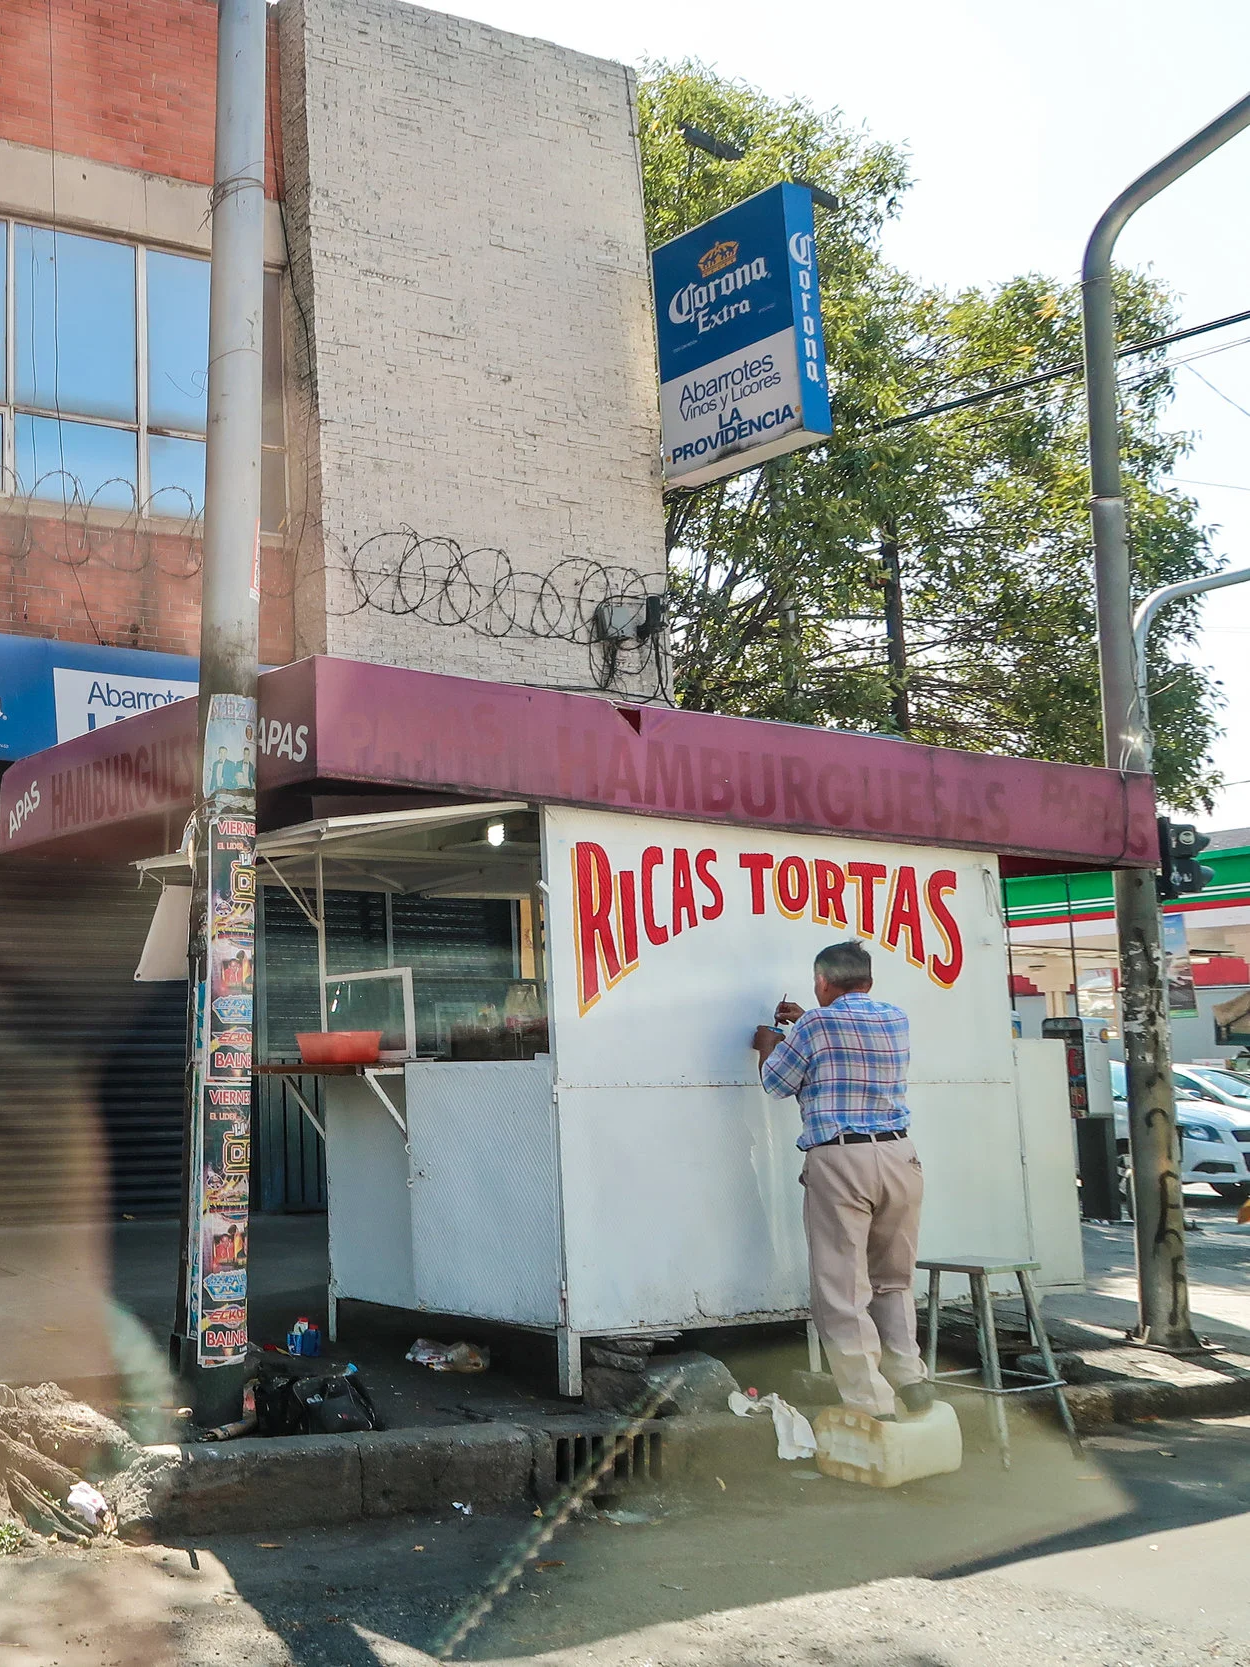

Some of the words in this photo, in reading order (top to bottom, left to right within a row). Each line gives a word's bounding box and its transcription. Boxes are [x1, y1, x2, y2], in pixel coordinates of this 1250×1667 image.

[668, 255, 769, 324] Corona
[697, 299, 751, 334] Extra
[788, 232, 820, 383] Corona
[679, 354, 774, 409] Abarrotes
[679, 395, 718, 422] Vinos
[719, 392, 730, 411] y
[731, 371, 781, 402] Licores
[672, 404, 795, 465] PROVIDENCIA
[718, 407, 743, 430] LA
[257, 717, 309, 763] APAS
[8, 780, 41, 839] APAS
[556, 725, 1011, 842] HAMBURGUESAS
[570, 841, 724, 1018] RICAS
[739, 852, 964, 989] TORTAS
